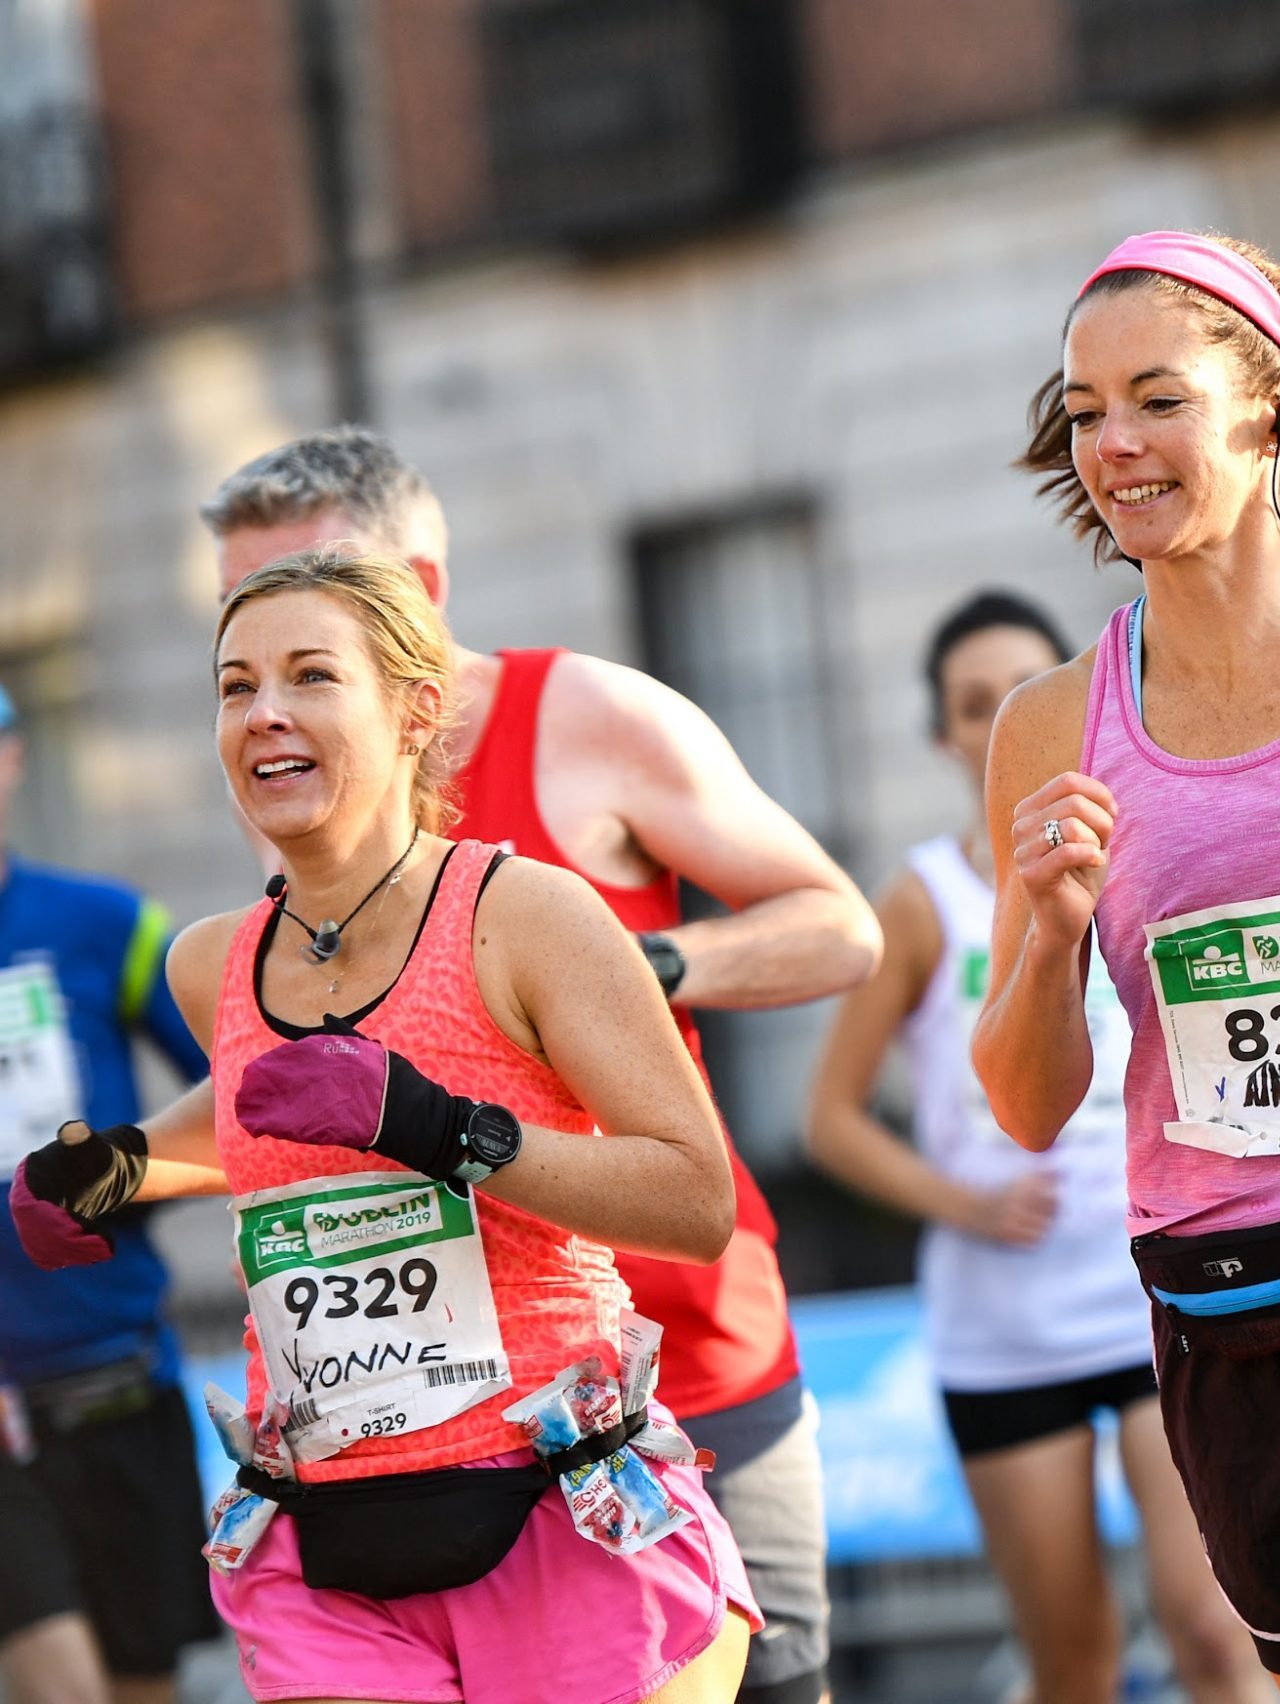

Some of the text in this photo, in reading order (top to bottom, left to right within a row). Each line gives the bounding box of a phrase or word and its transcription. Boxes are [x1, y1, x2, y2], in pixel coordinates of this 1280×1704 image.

[1193, 961, 1243, 981] KBC
[320, 1211, 432, 1249] MARATHON 2019
[284, 1258, 438, 1331] 9329
[366, 1402, 396, 1417] T-SHIRT
[360, 1412, 408, 1438] 9329
